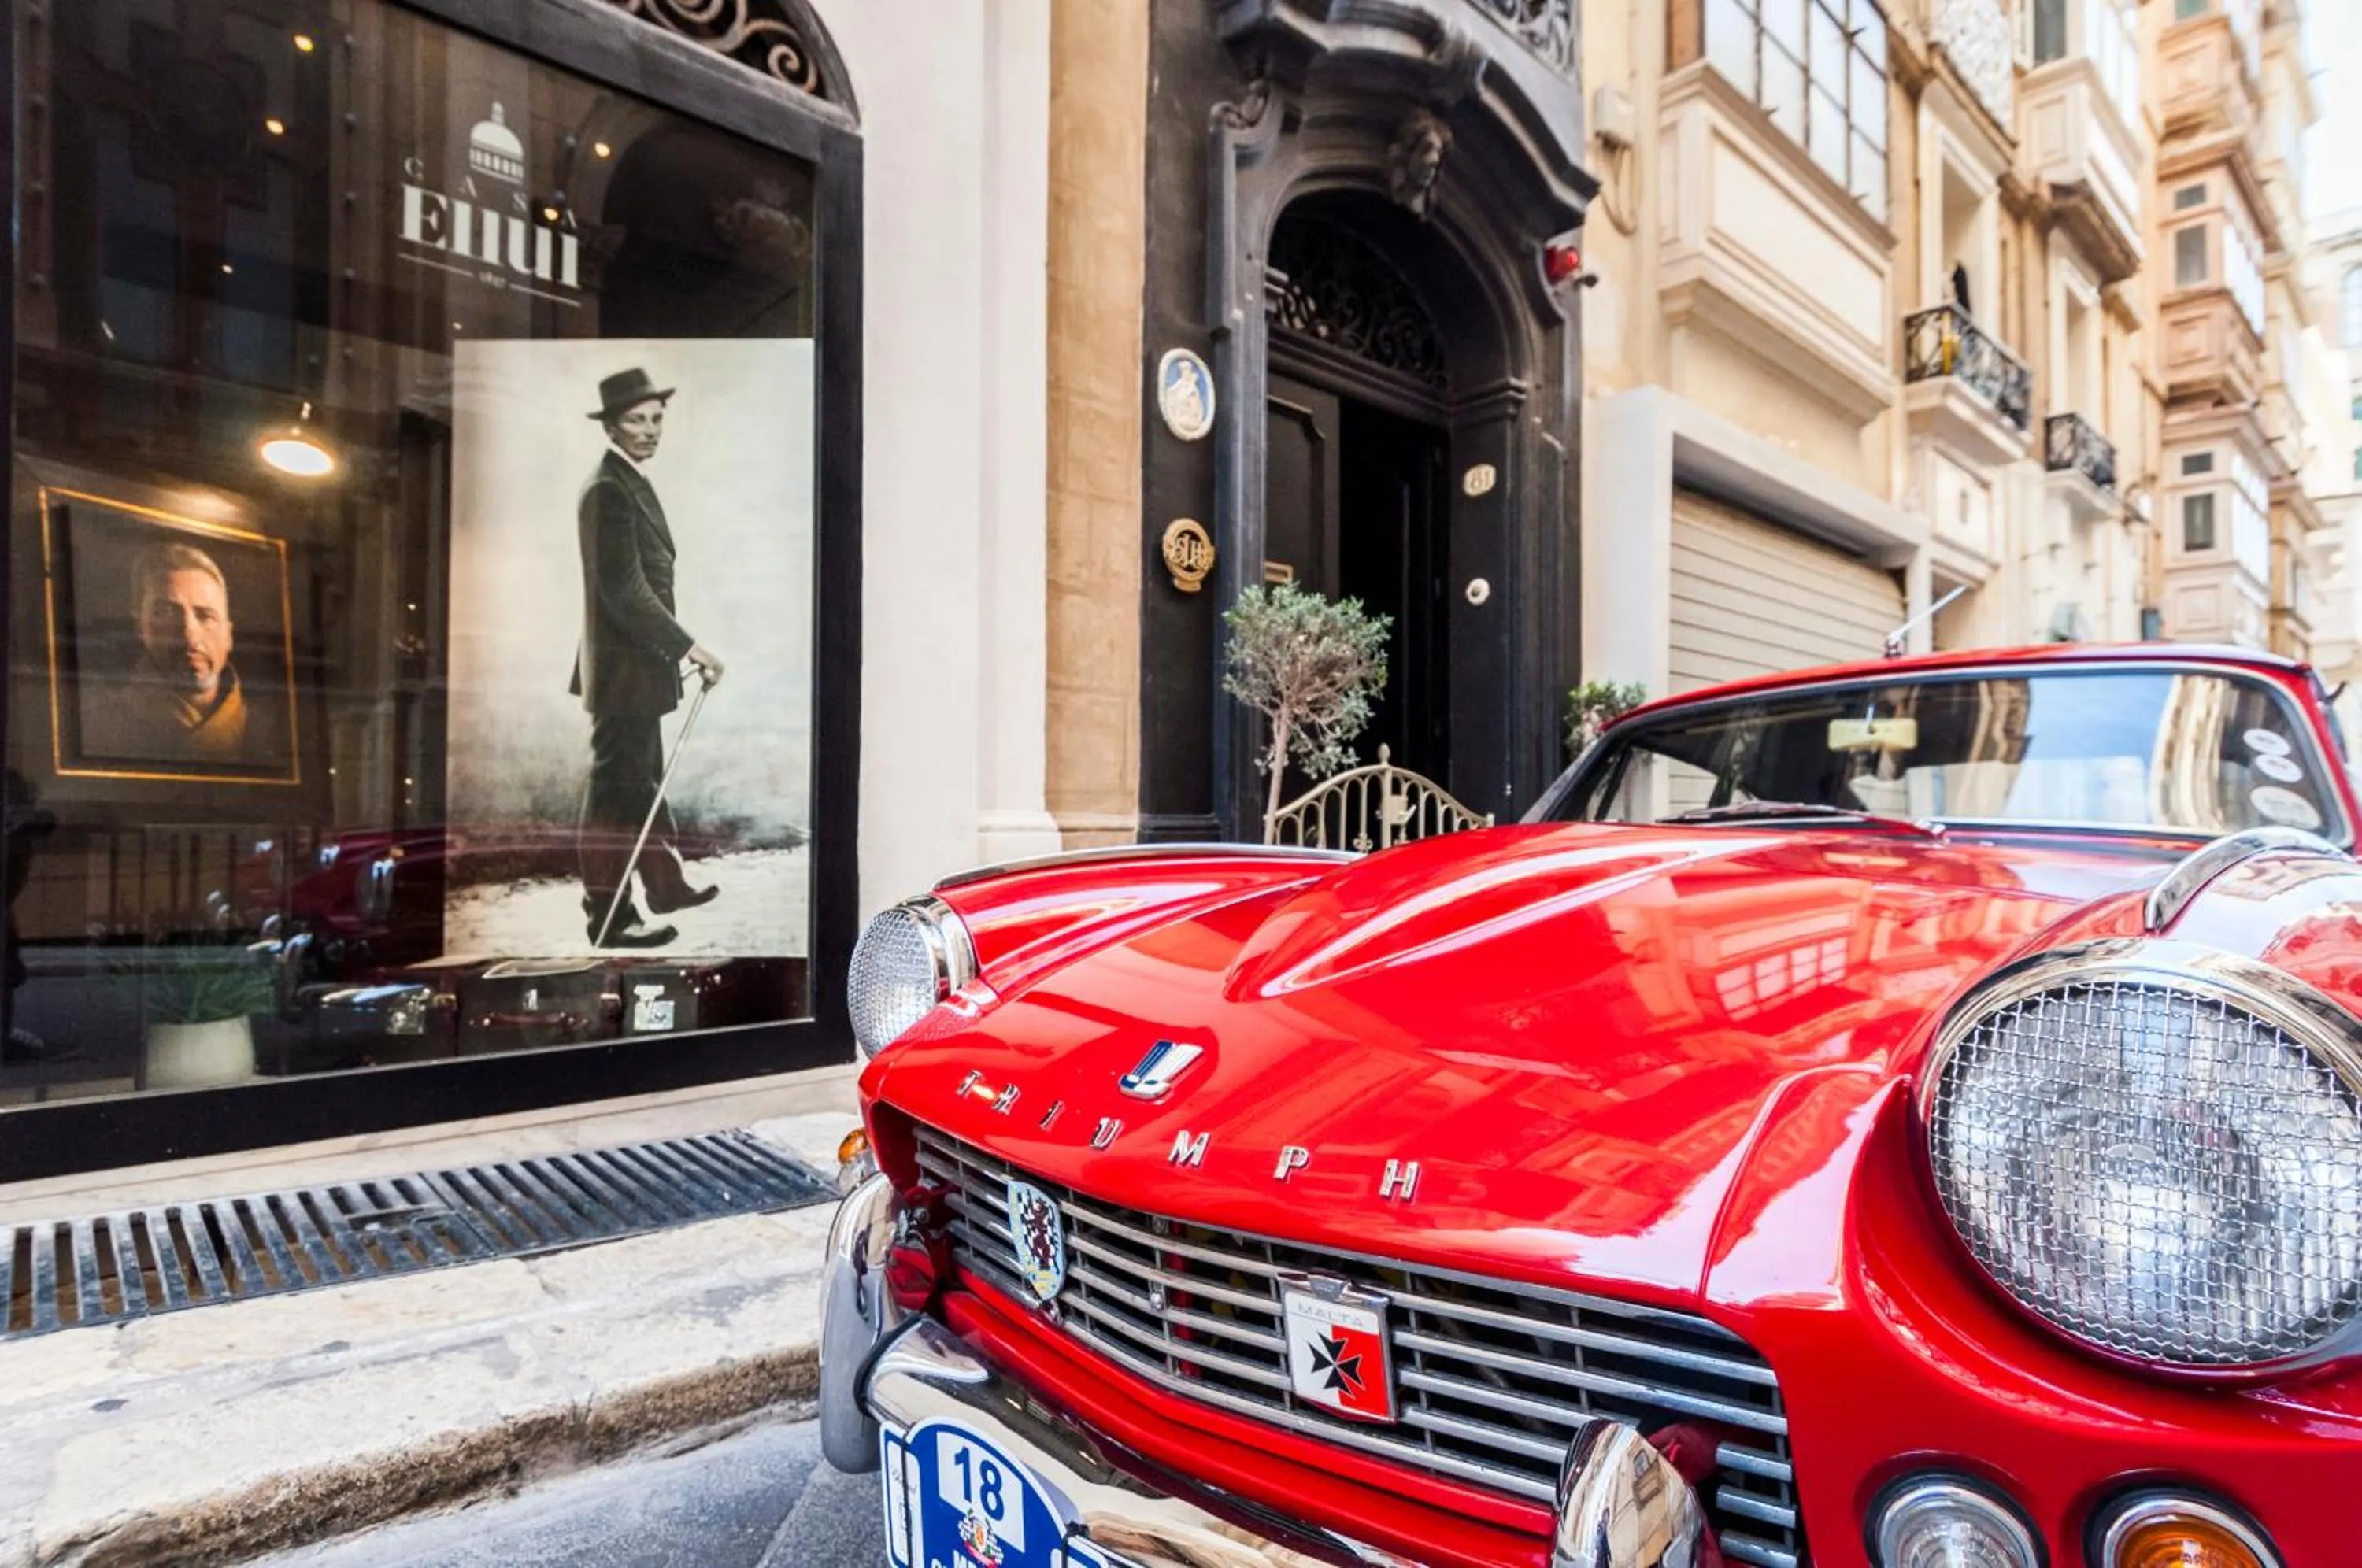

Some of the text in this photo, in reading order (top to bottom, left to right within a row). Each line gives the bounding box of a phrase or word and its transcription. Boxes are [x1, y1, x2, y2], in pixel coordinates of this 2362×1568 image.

[398, 183, 581, 289] Ellul
[956, 1069, 1420, 1202] TRIUMPH
[1298, 1303, 1364, 1328] MALTA
[954, 1446, 1005, 1522] 18
